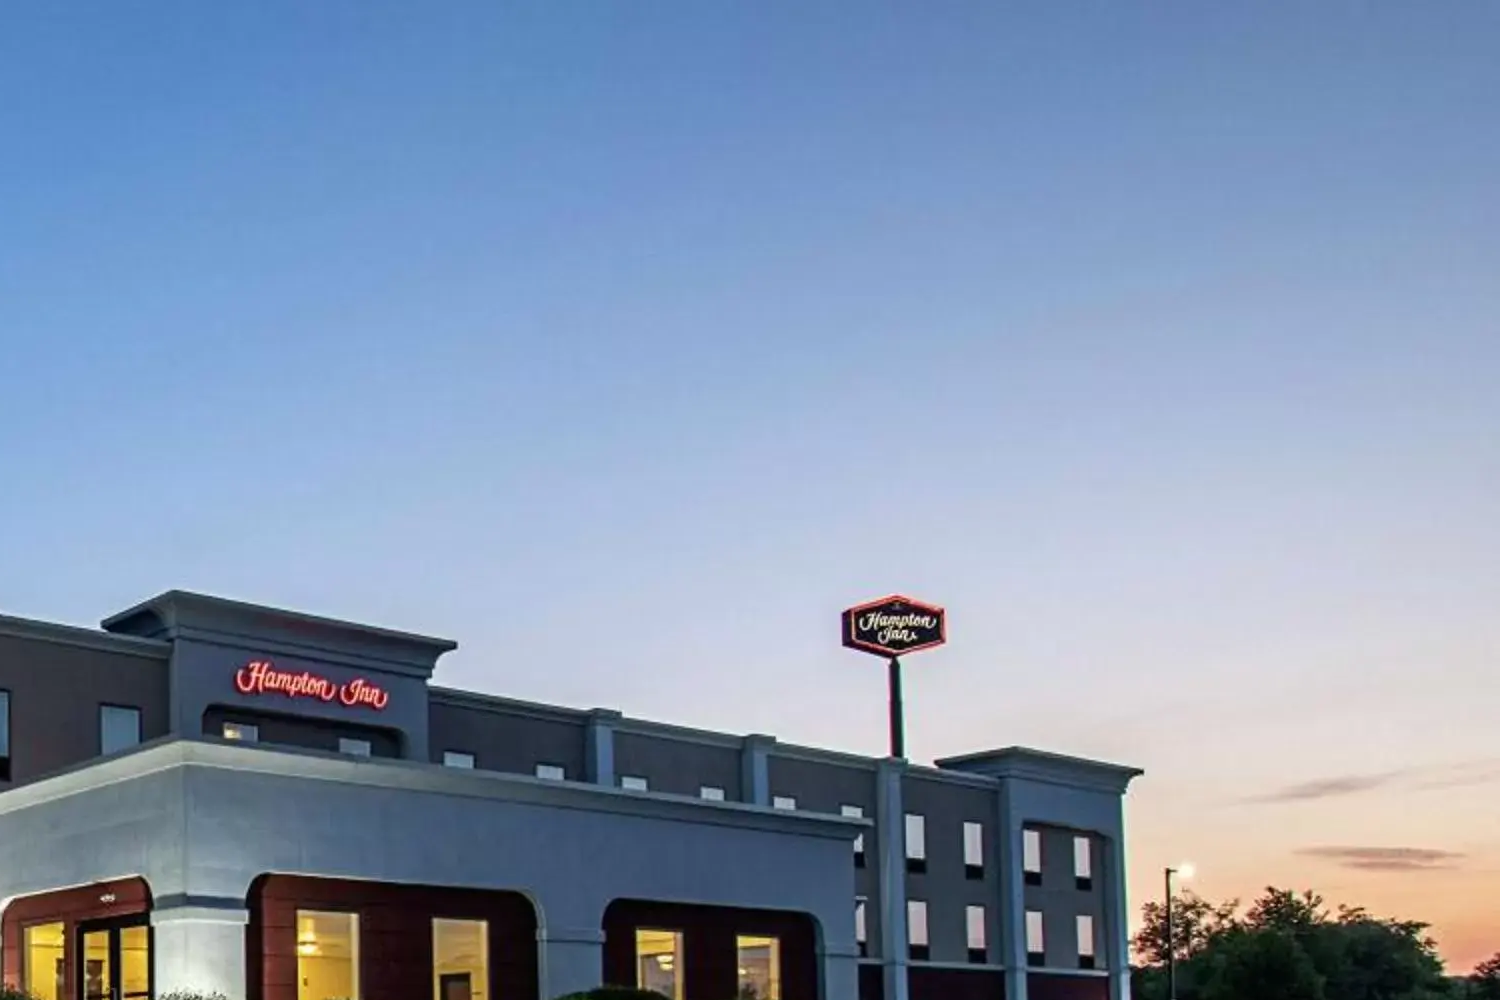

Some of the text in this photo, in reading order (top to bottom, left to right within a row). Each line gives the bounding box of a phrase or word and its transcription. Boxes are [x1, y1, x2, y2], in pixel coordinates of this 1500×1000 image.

[858, 611, 937, 631] Hampton
[877, 626, 917, 644] Inn
[236, 660, 388, 709] Hampton Inn
